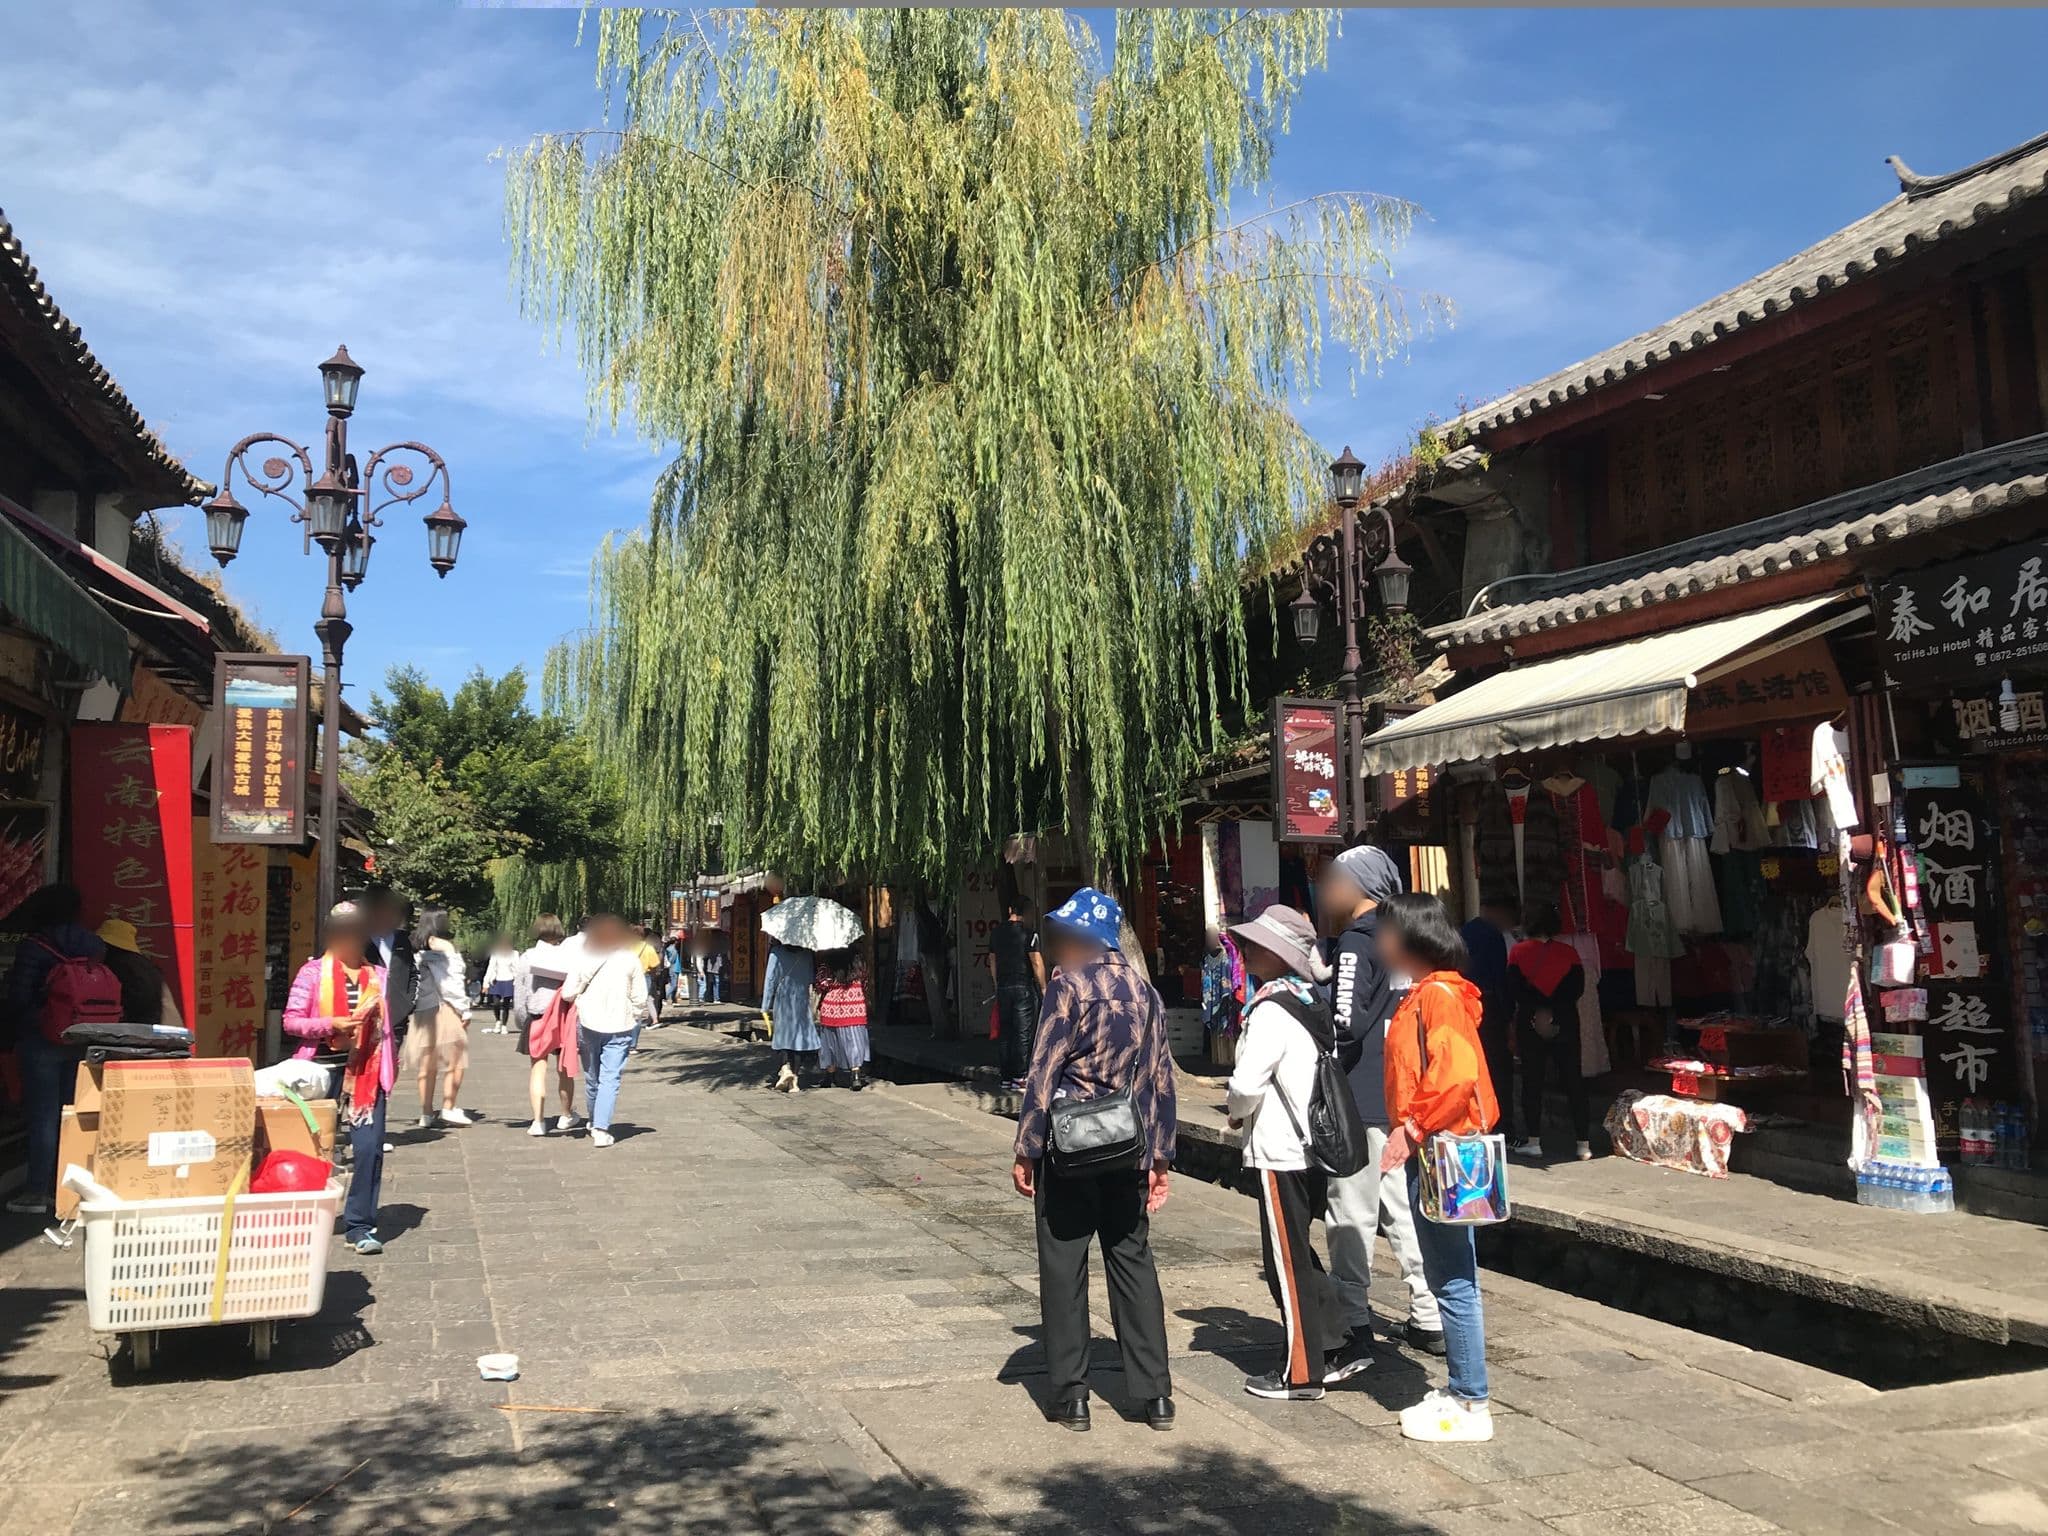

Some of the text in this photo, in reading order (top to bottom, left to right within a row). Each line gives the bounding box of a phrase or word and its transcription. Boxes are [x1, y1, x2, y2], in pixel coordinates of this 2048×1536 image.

[1886, 556, 2048, 645] 泰和居
[1975, 616, 2048, 650] 精品客
